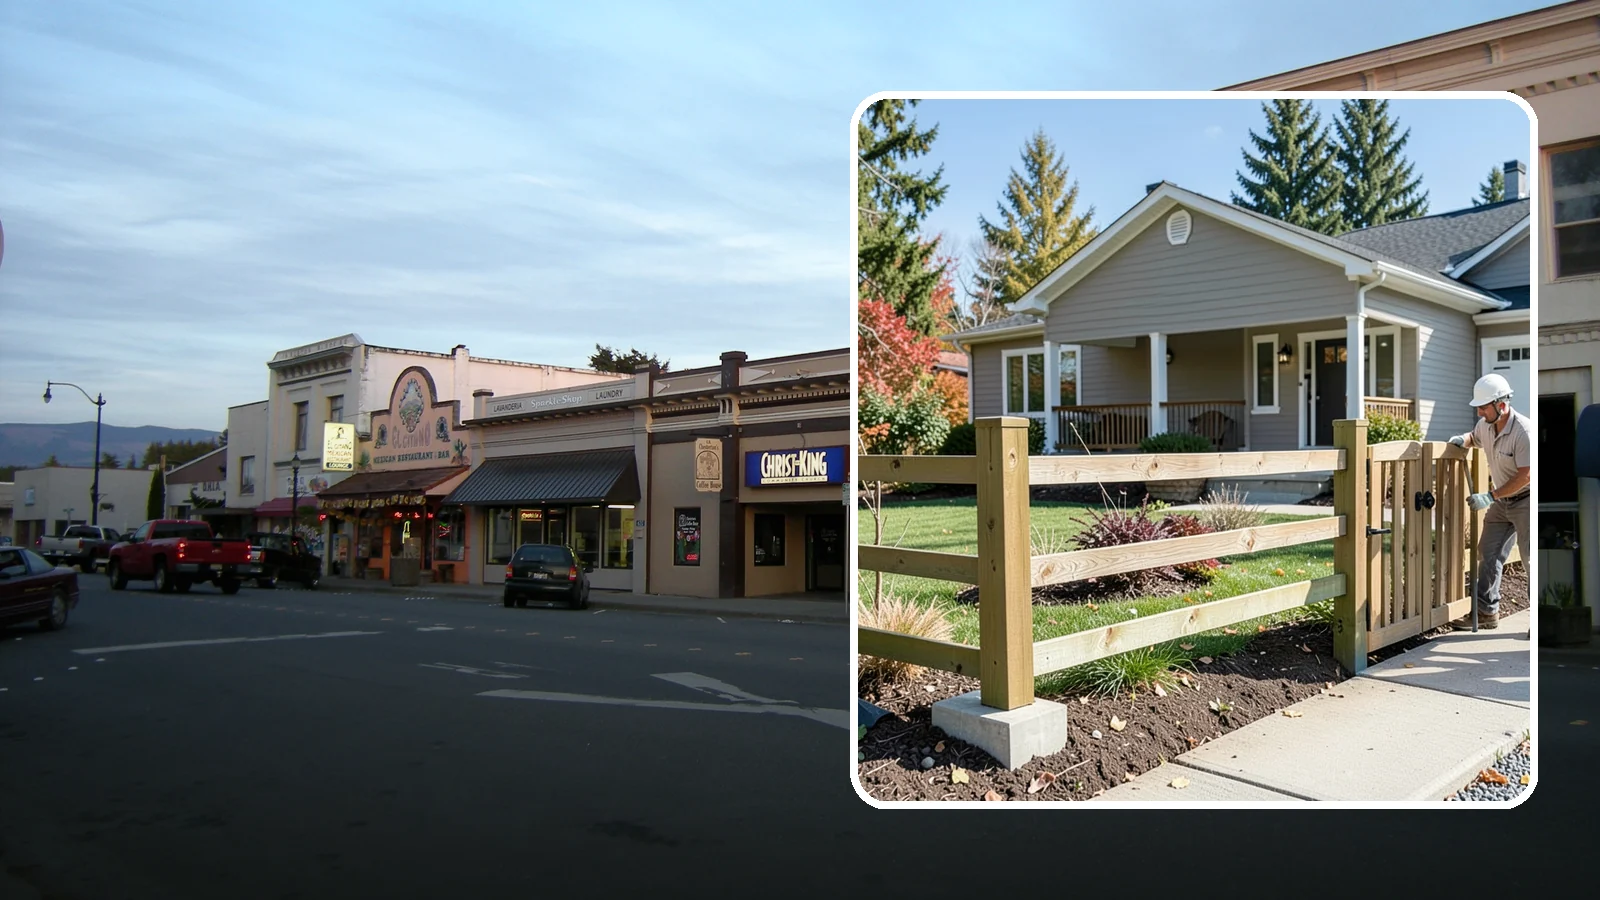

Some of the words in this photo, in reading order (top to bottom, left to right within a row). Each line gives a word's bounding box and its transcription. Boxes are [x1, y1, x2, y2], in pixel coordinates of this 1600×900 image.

[494, 402, 522, 412] LAVANDERIA
[561, 394, 582, 405] Shop
[595, 389, 624, 400] LAUNDRY
[373, 455, 396, 464] MEXICAN
[397, 451, 433, 462] RESTAURANT
[438, 450, 450, 459] BAR
[760, 452, 797, 478] CHRIST
[799, 449, 827, 476] KING
[696, 480, 709, 489] Coffee
